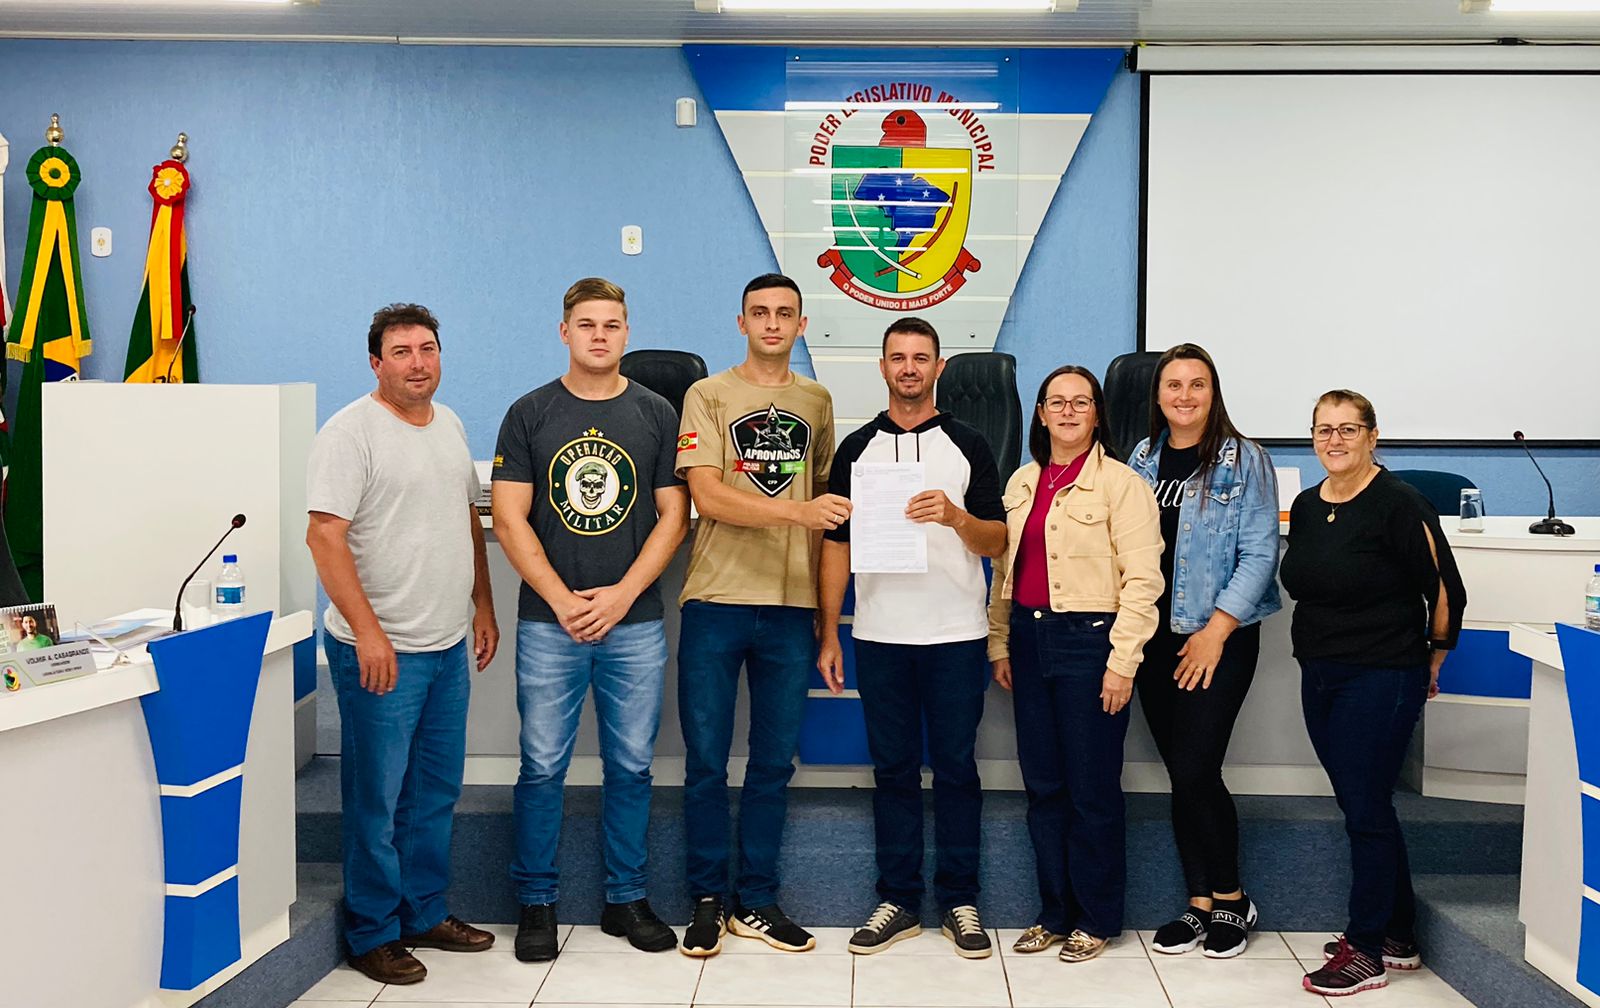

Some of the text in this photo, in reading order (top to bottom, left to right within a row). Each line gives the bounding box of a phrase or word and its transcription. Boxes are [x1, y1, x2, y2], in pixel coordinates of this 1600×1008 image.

[809, 82, 995, 172] PODER LEGISLATIVO MUNICIPAL
[842, 282, 953, 309] O PODER UNIDO É MAIS FORTE
[744, 448, 801, 461] APROVADOS
[560, 499, 625, 530] MILITAR
